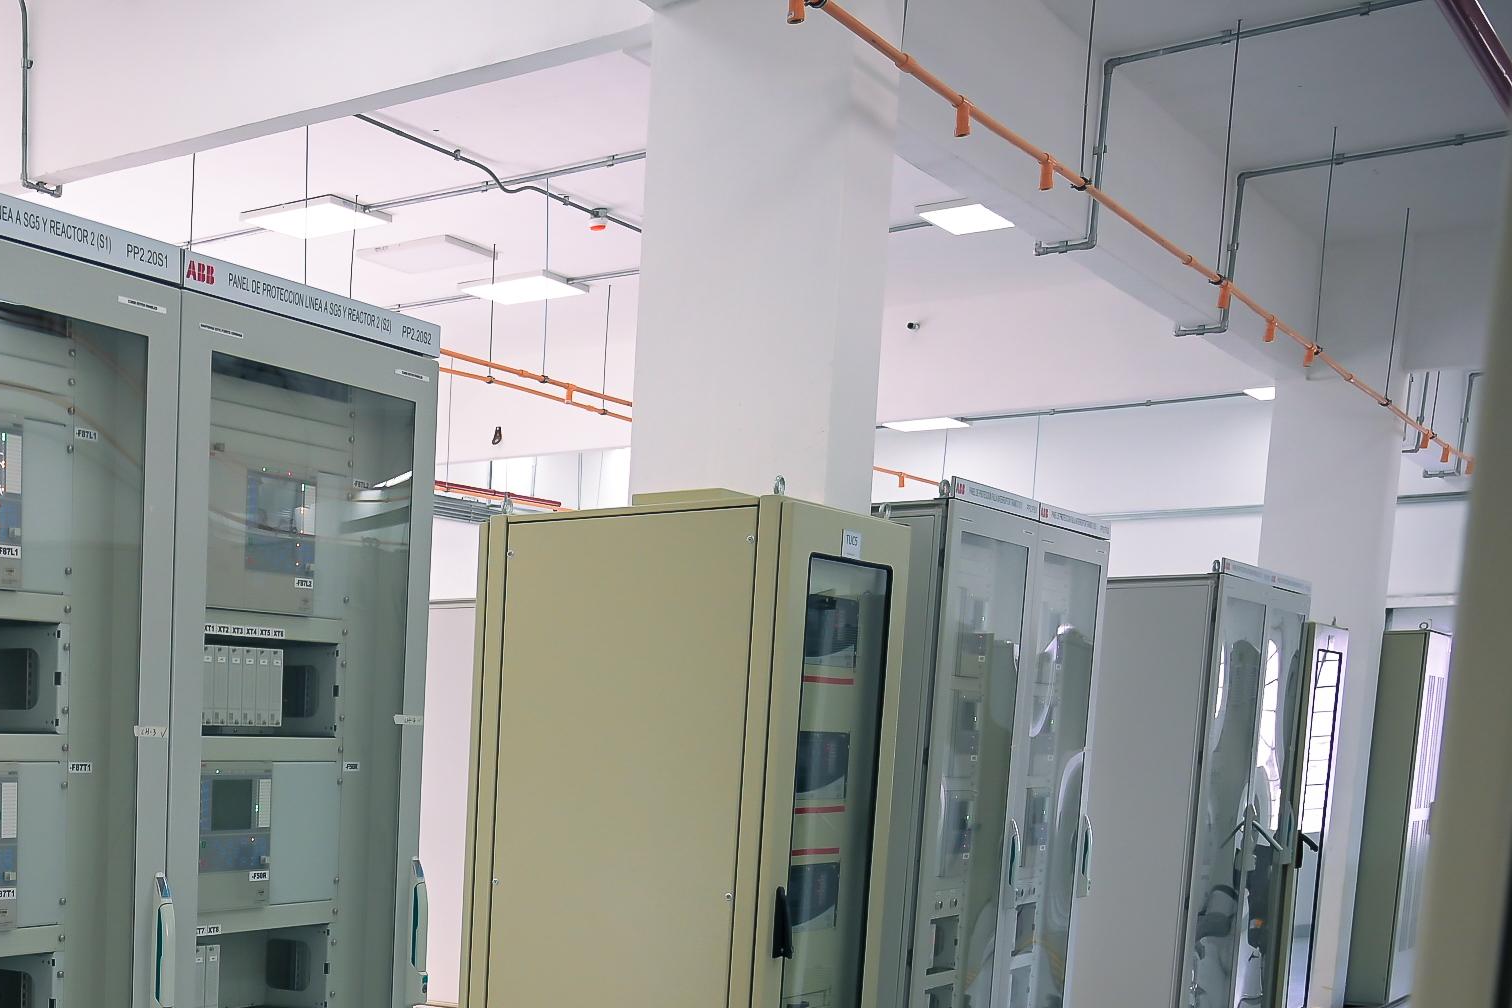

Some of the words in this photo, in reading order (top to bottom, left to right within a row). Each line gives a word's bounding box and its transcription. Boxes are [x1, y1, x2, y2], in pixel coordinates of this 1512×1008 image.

[15, 210, 22, 225] A
[23, 212, 40, 231] SG5
[41, 218, 48, 233] Y
[49, 219, 89, 245] REACTOR
[90, 232, 96, 247] 2
[96, 234, 113, 255] (S1)
[126, 243, 169, 269] PP2.20S1
[185, 260, 215, 285] ABB
[228, 272, 250, 292] PANEL
[251, 280, 261, 295] DE
[262, 283, 304, 307] PROTECCION
[305, 296, 323, 313] LINEA
[323, 301, 328, 314] A
[342, 306, 347, 318] Y
[347, 308, 376, 328] REACTOR
[376, 316, 380, 329] 2
[401, 325, 432, 345] PP2.20S2
[217, 625, 229, 633] XT2
[232, 627, 243, 635] XT3
[246, 627, 257, 635] XT4
